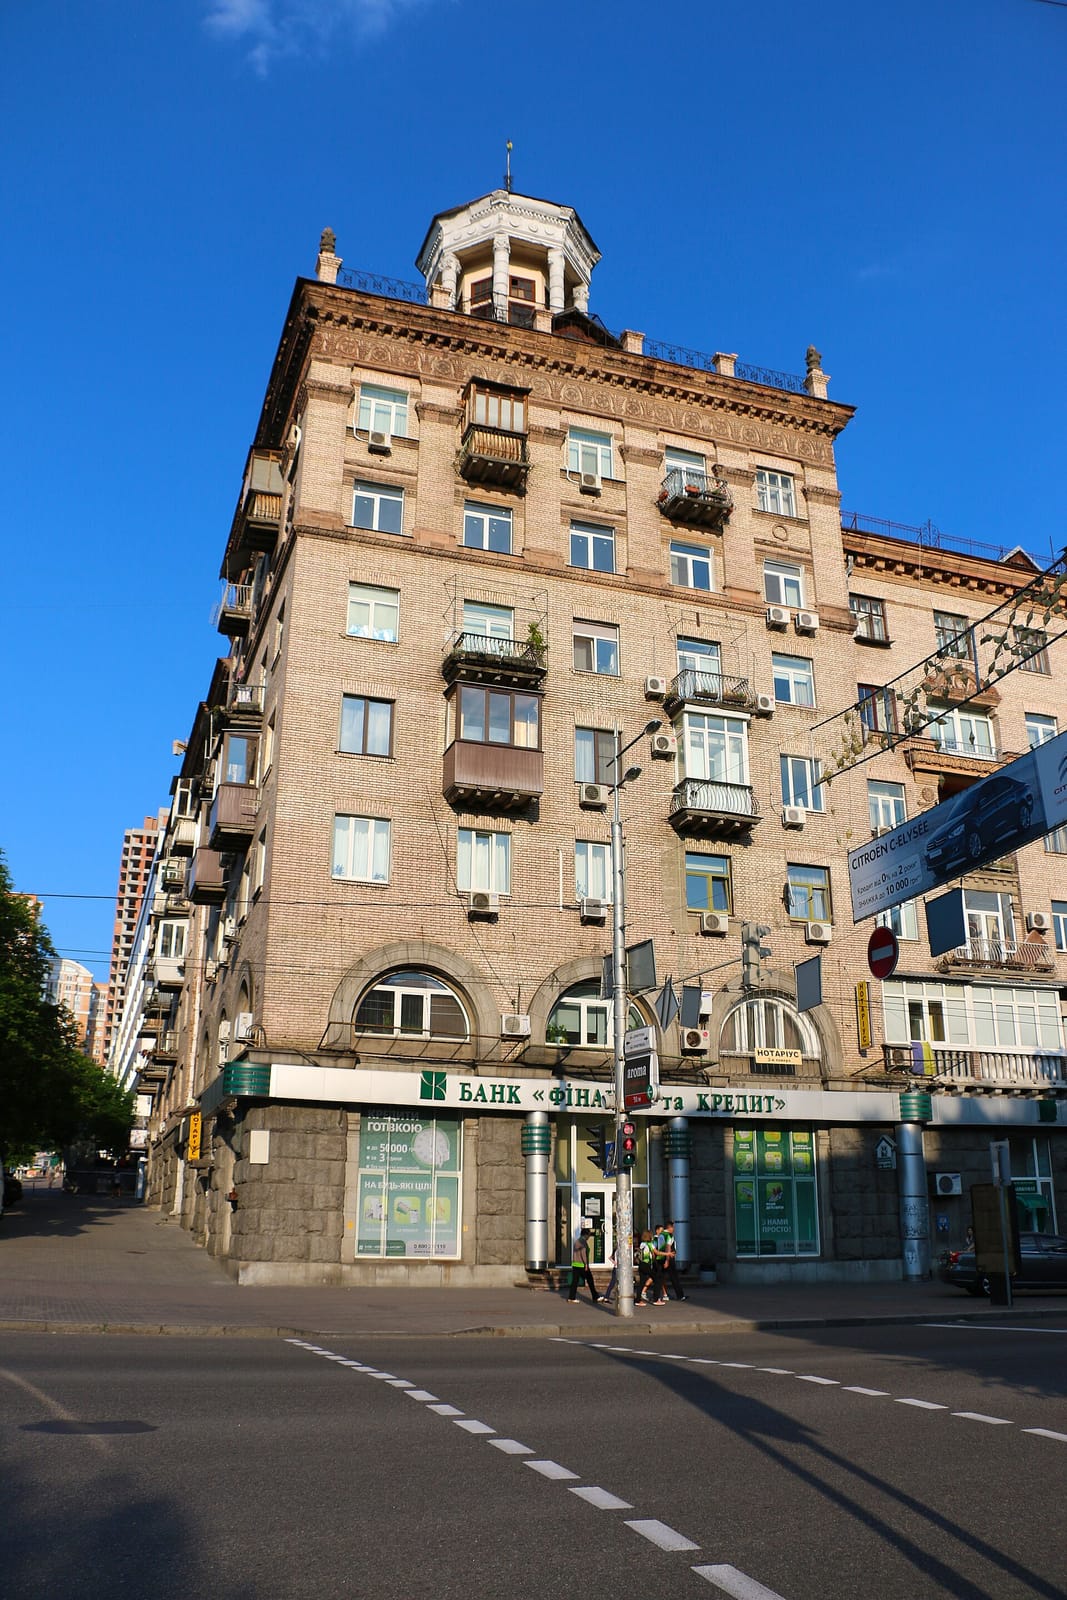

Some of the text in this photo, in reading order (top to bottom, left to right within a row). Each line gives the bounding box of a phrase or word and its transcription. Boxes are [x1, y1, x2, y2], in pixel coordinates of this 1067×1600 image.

[851, 820, 929, 870] CITROËN C-ELYSÉE
[898, 865, 903, 875] 2
[858, 893, 878, 908] ЗНИЖКА
[859, 983, 867, 1043] НОТАРІУС
[757, 1050, 799, 1058] НОТАРІУС
[627, 1065, 647, 1079] aroma
[459, 1082, 521, 1104] БАНК
[662, 1096, 684, 1110] та
[696, 1093, 786, 1114] КРЕДИТ»
[367, 1121, 423, 1133] ГОТІВКОЮ
[379, 1143, 408, 1153] 50000
[379, 1153, 385, 1162] 3
[364, 1181, 377, 1189] НА
[767, 1218, 788, 1226] НАМИ
